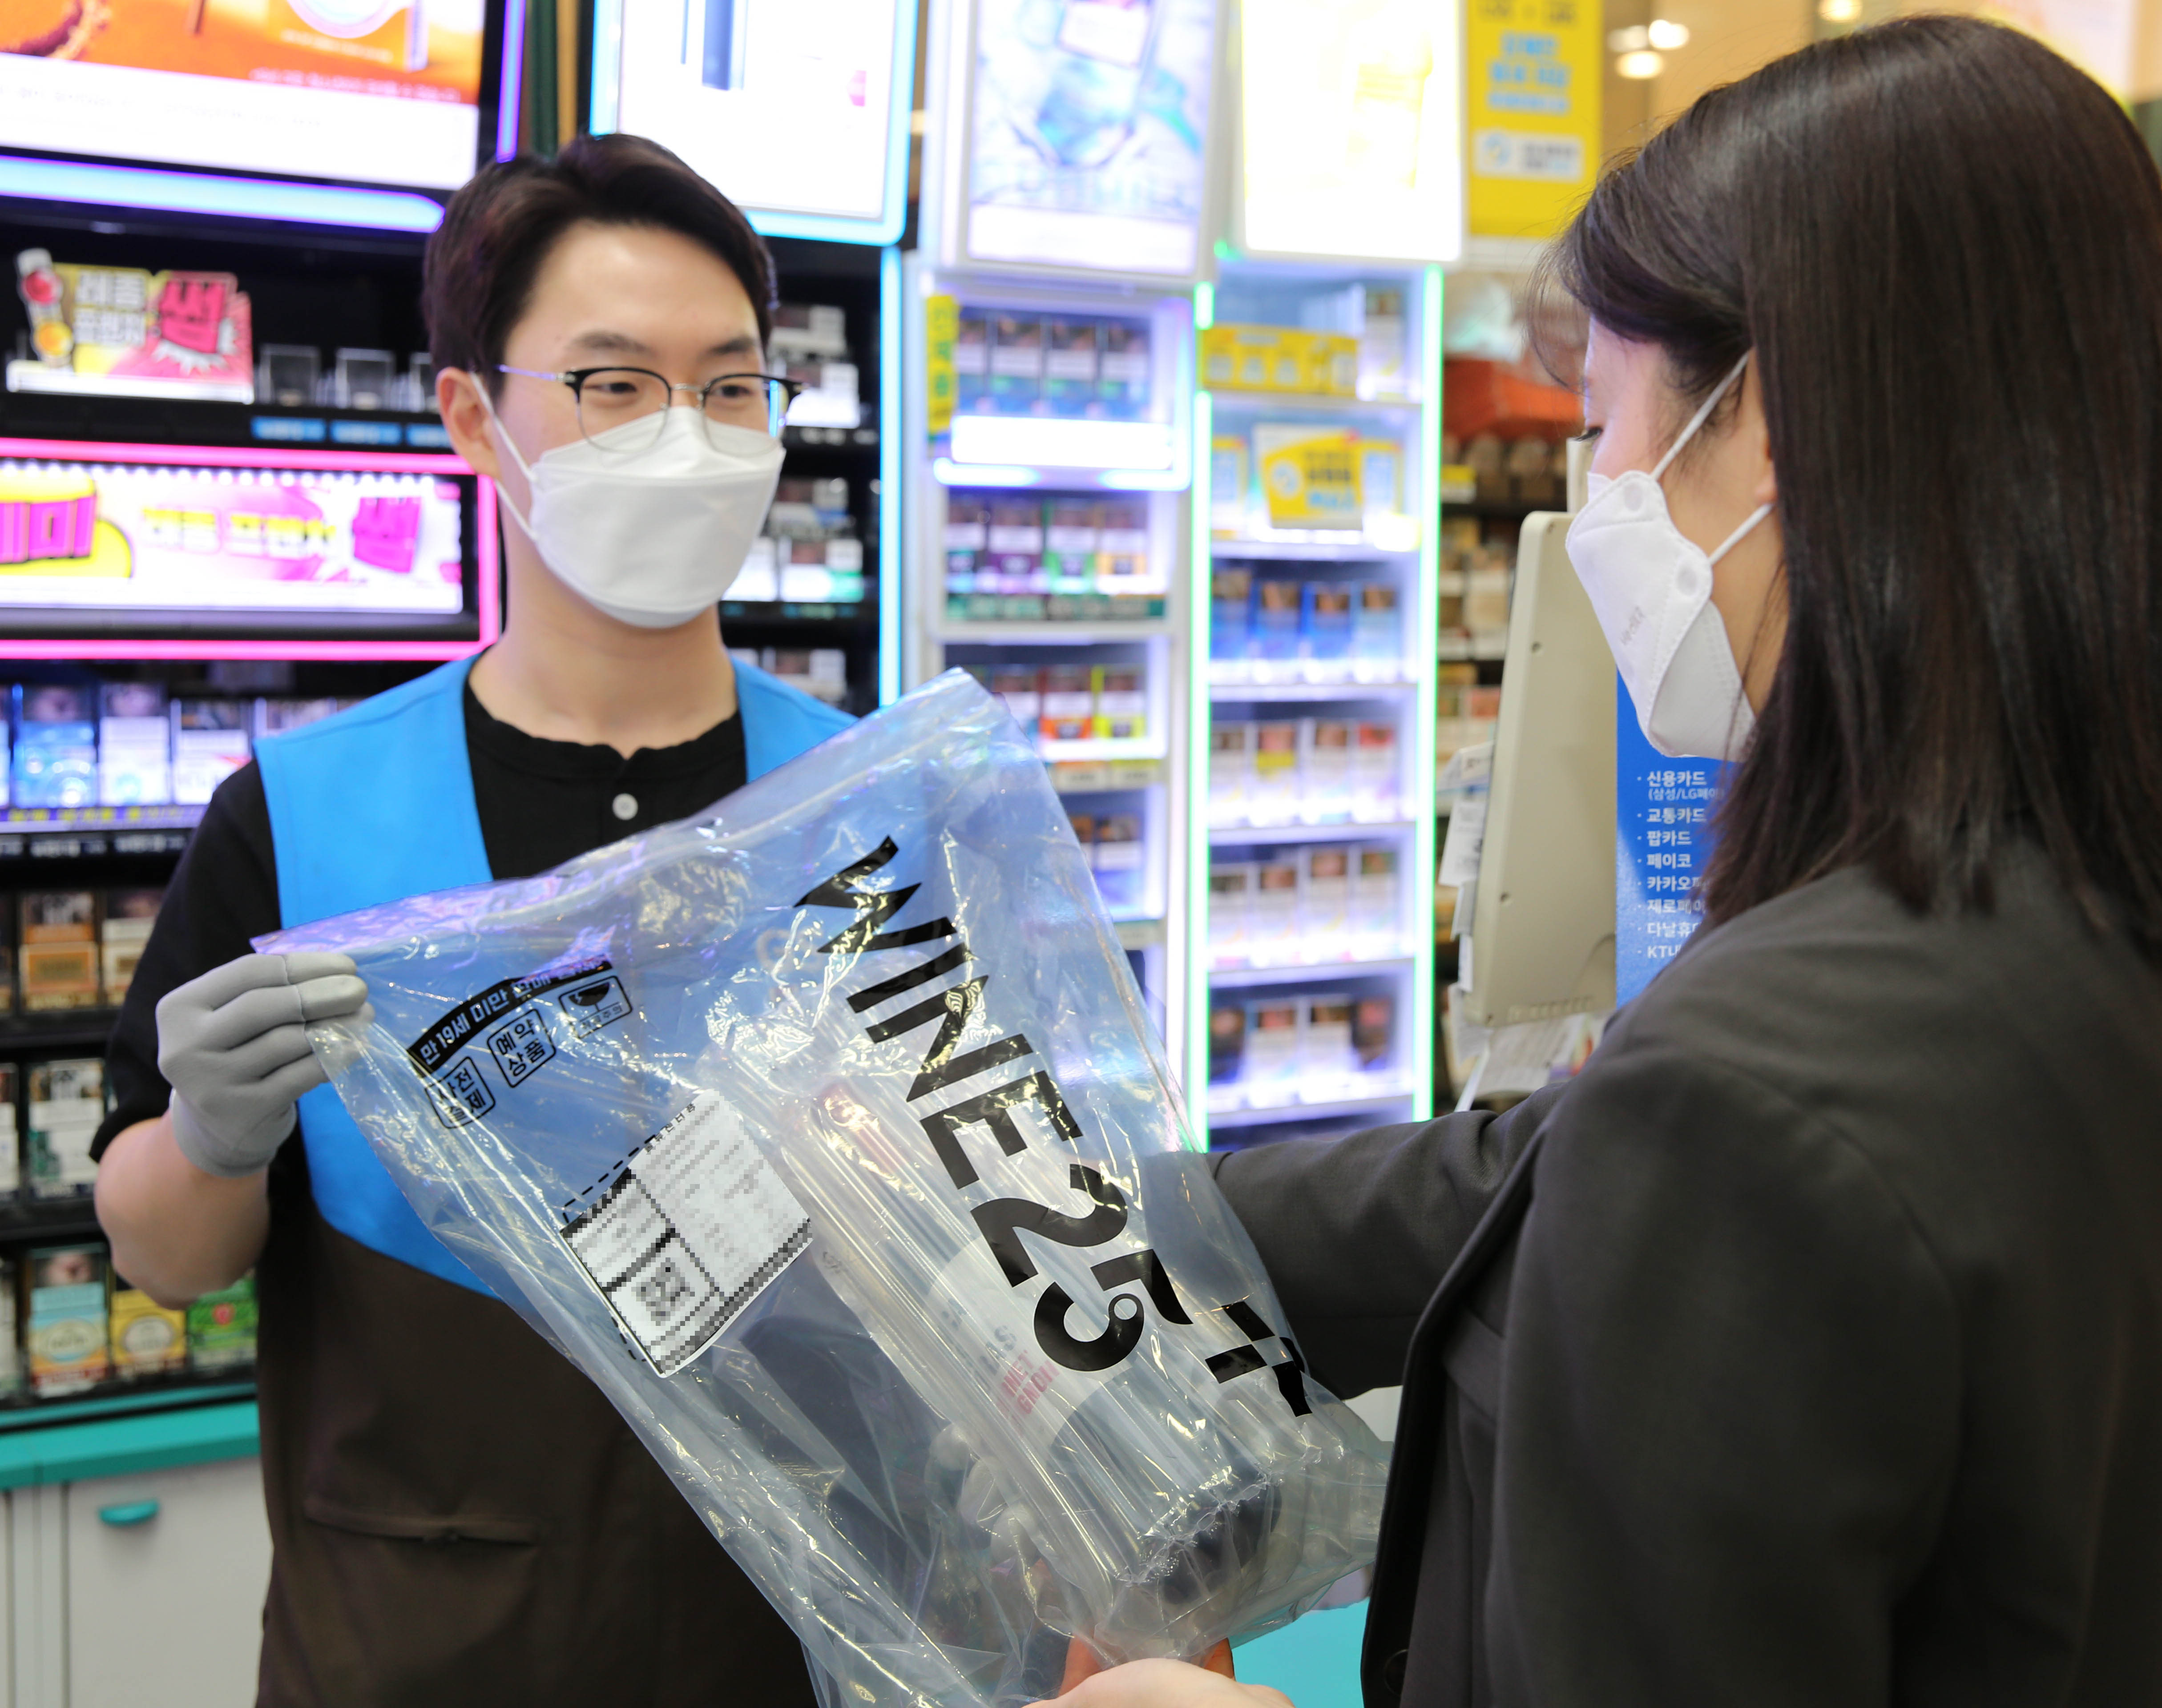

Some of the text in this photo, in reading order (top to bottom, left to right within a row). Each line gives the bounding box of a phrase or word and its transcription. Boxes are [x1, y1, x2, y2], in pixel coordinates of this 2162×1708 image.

[1647, 770, 1707, 787] 신용카드
[1646, 807, 1707, 825] 교통카드
[1647, 830, 1692, 847] 팝카드
[1646, 853, 1692, 869] 페이코
[420, 1039, 441, 1066] 만
[436, 1012, 472, 1049] 19세
[469, 988, 510, 1023] 미만
[496, 1019, 535, 1055] 예약
[508, 1038, 546, 1077] 상품
